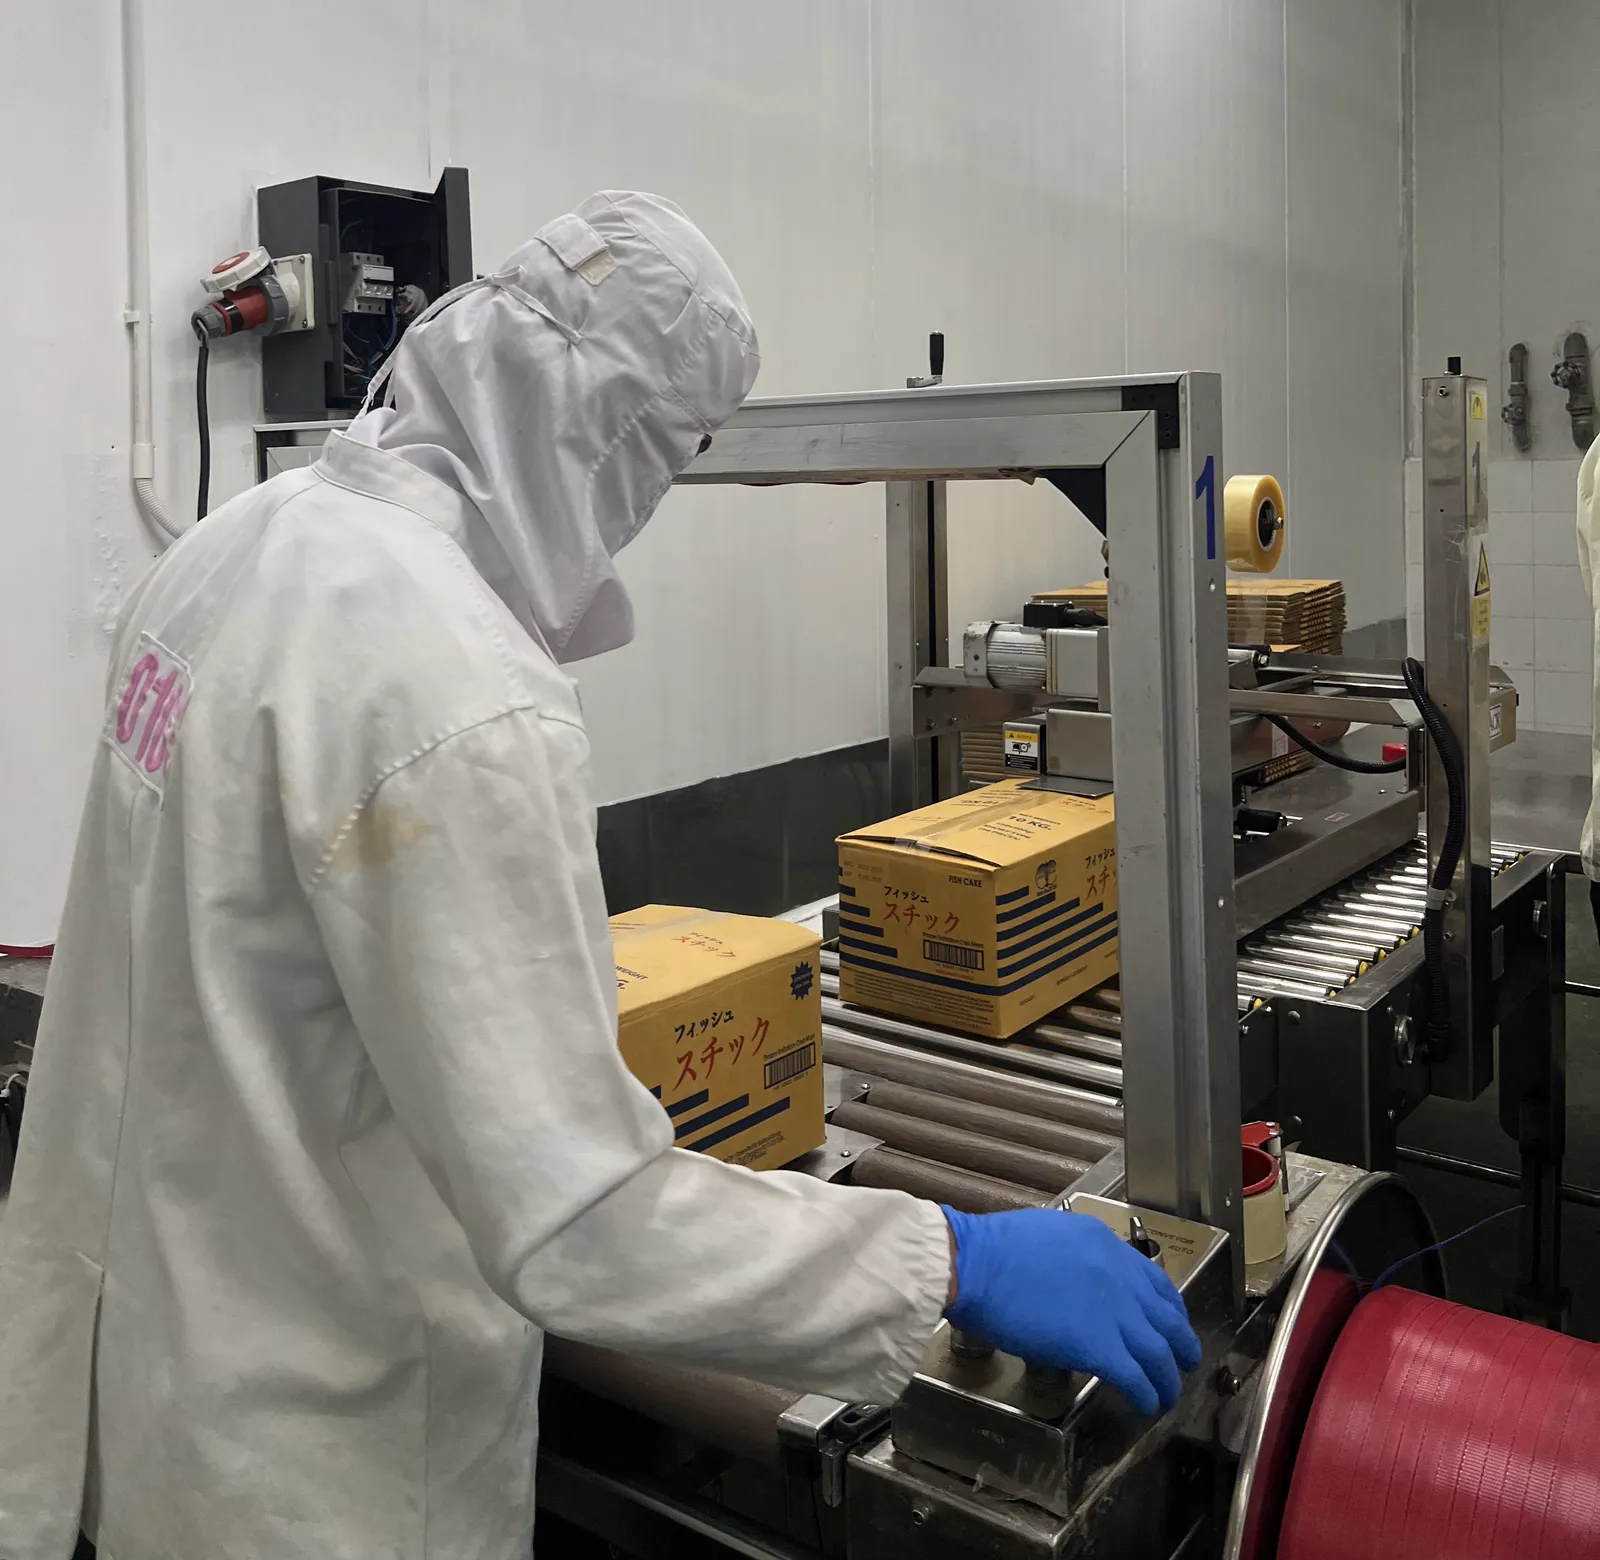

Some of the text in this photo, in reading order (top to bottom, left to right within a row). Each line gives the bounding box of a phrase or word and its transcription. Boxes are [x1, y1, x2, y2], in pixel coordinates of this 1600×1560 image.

[1195, 455, 1216, 560] 1
[1009, 815, 1027, 823] 10
[1027, 820, 1052, 831] KG.
[948, 875, 983, 888] FISH CAKE
[883, 885, 929, 904] フィッシュ
[882, 901, 960, 934] スチック
[615, 965, 649, 981] WEIGHT
[674, 1010, 735, 1045] フィッシュ
[672, 1016, 770, 1092] スチック
[1144, 1227, 1195, 1246] CONVEYOR
[1167, 1244, 1195, 1256] AUTO
